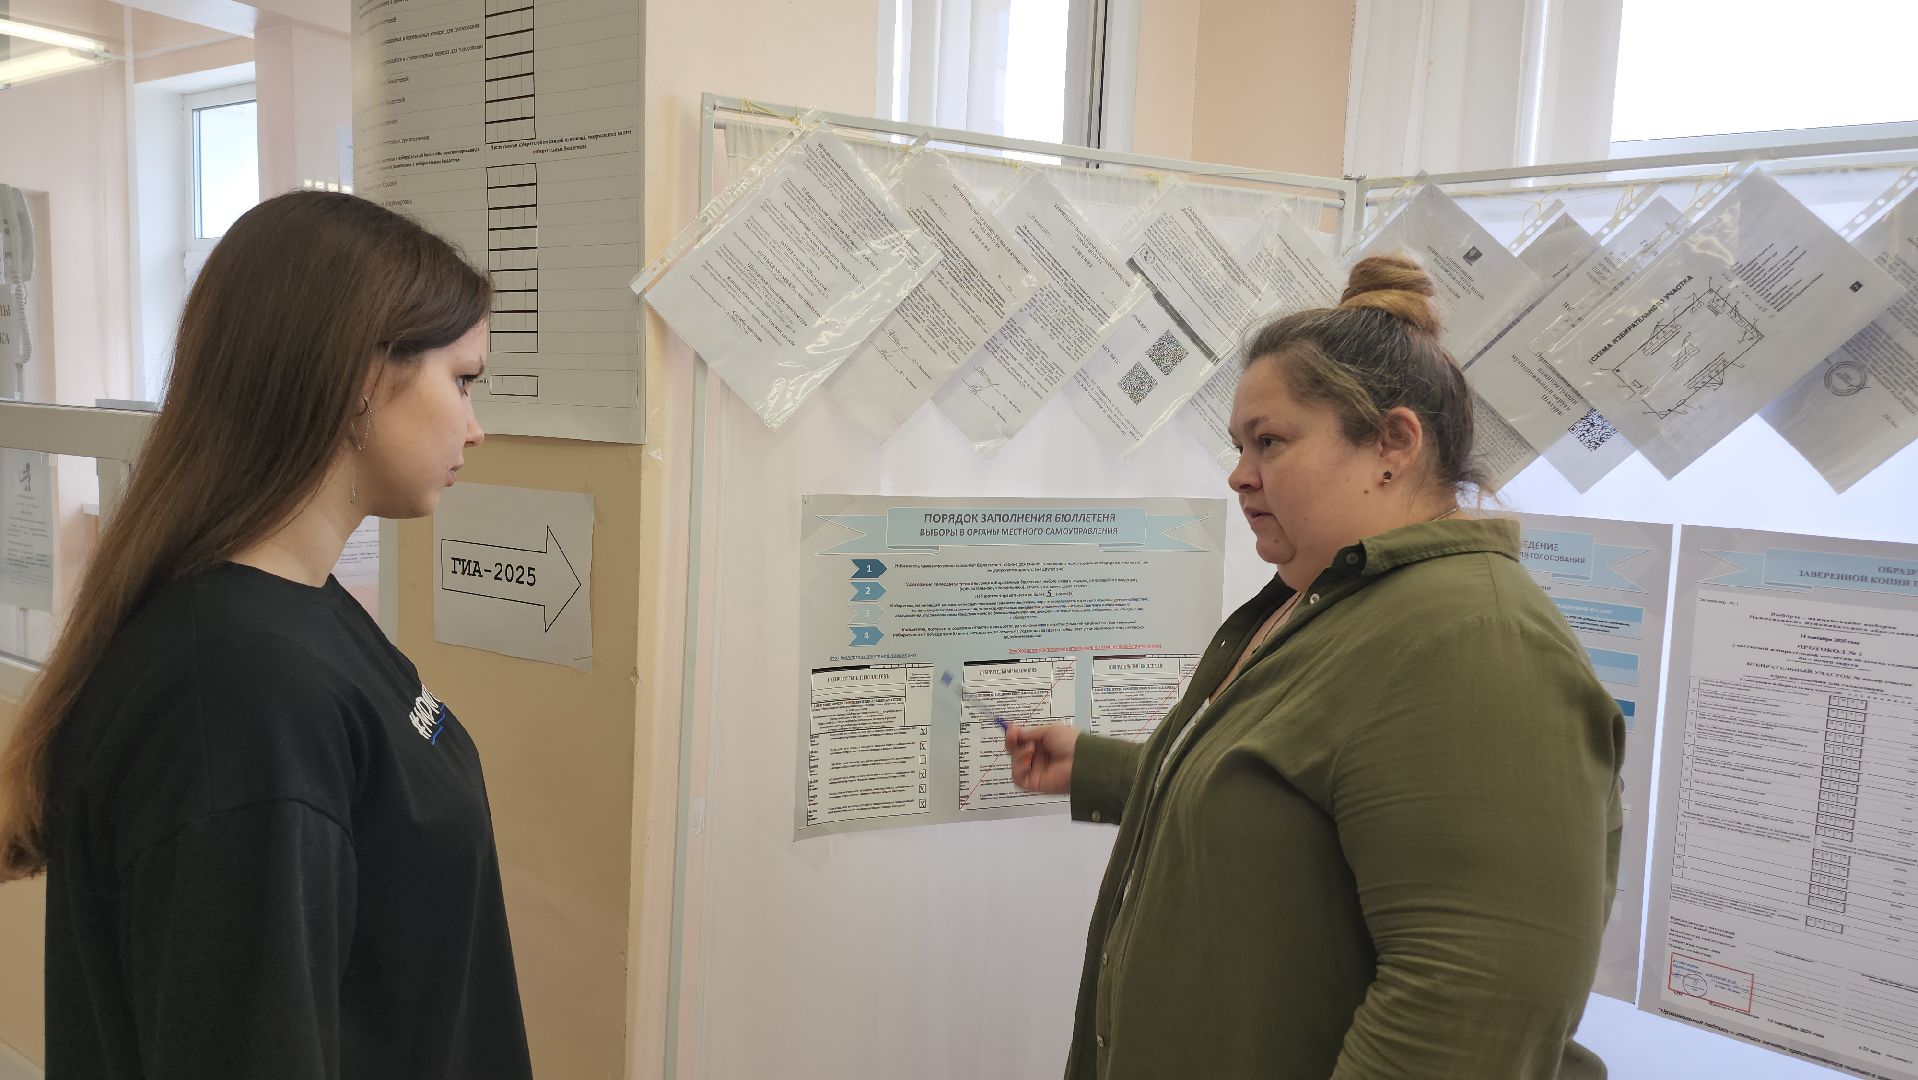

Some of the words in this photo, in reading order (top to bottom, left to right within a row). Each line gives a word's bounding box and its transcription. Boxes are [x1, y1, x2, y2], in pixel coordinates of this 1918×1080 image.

[1588, 340, 1614, 364] СХЕМА
[1609, 297, 1666, 345] ИЗБИРАТЕЛЬНОГО
[1661, 272, 1695, 301] УЧАСТКА
[924, 512, 978, 525] ПОРЯДОК
[981, 512, 1052, 524] ЗАПОЛНЕНИЯ
[1054, 512, 1115, 524] БЮЛЛЕТЕНЯ
[919, 527, 957, 537] ВЫБОРЫ
[966, 527, 998, 537] ОРГАНЫ
[1001, 526, 1043, 536] МЕСТНОГО
[1045, 526, 1117, 536] САМОУПРАВЛЕНИЯ
[1529, 552, 1585, 564] ГОЛОСОВАНИЯ
[450, 557, 537, 587] ГИА-2025
[866, 564, 872, 573] 1
[1798, 567, 1868, 583] ЗАВЕРЕННОЙ
[1870, 575, 1910, 587] КОПИИ
[865, 586, 870, 595] 2
[864, 609, 870, 618] 3
[864, 632, 870, 640] 4
